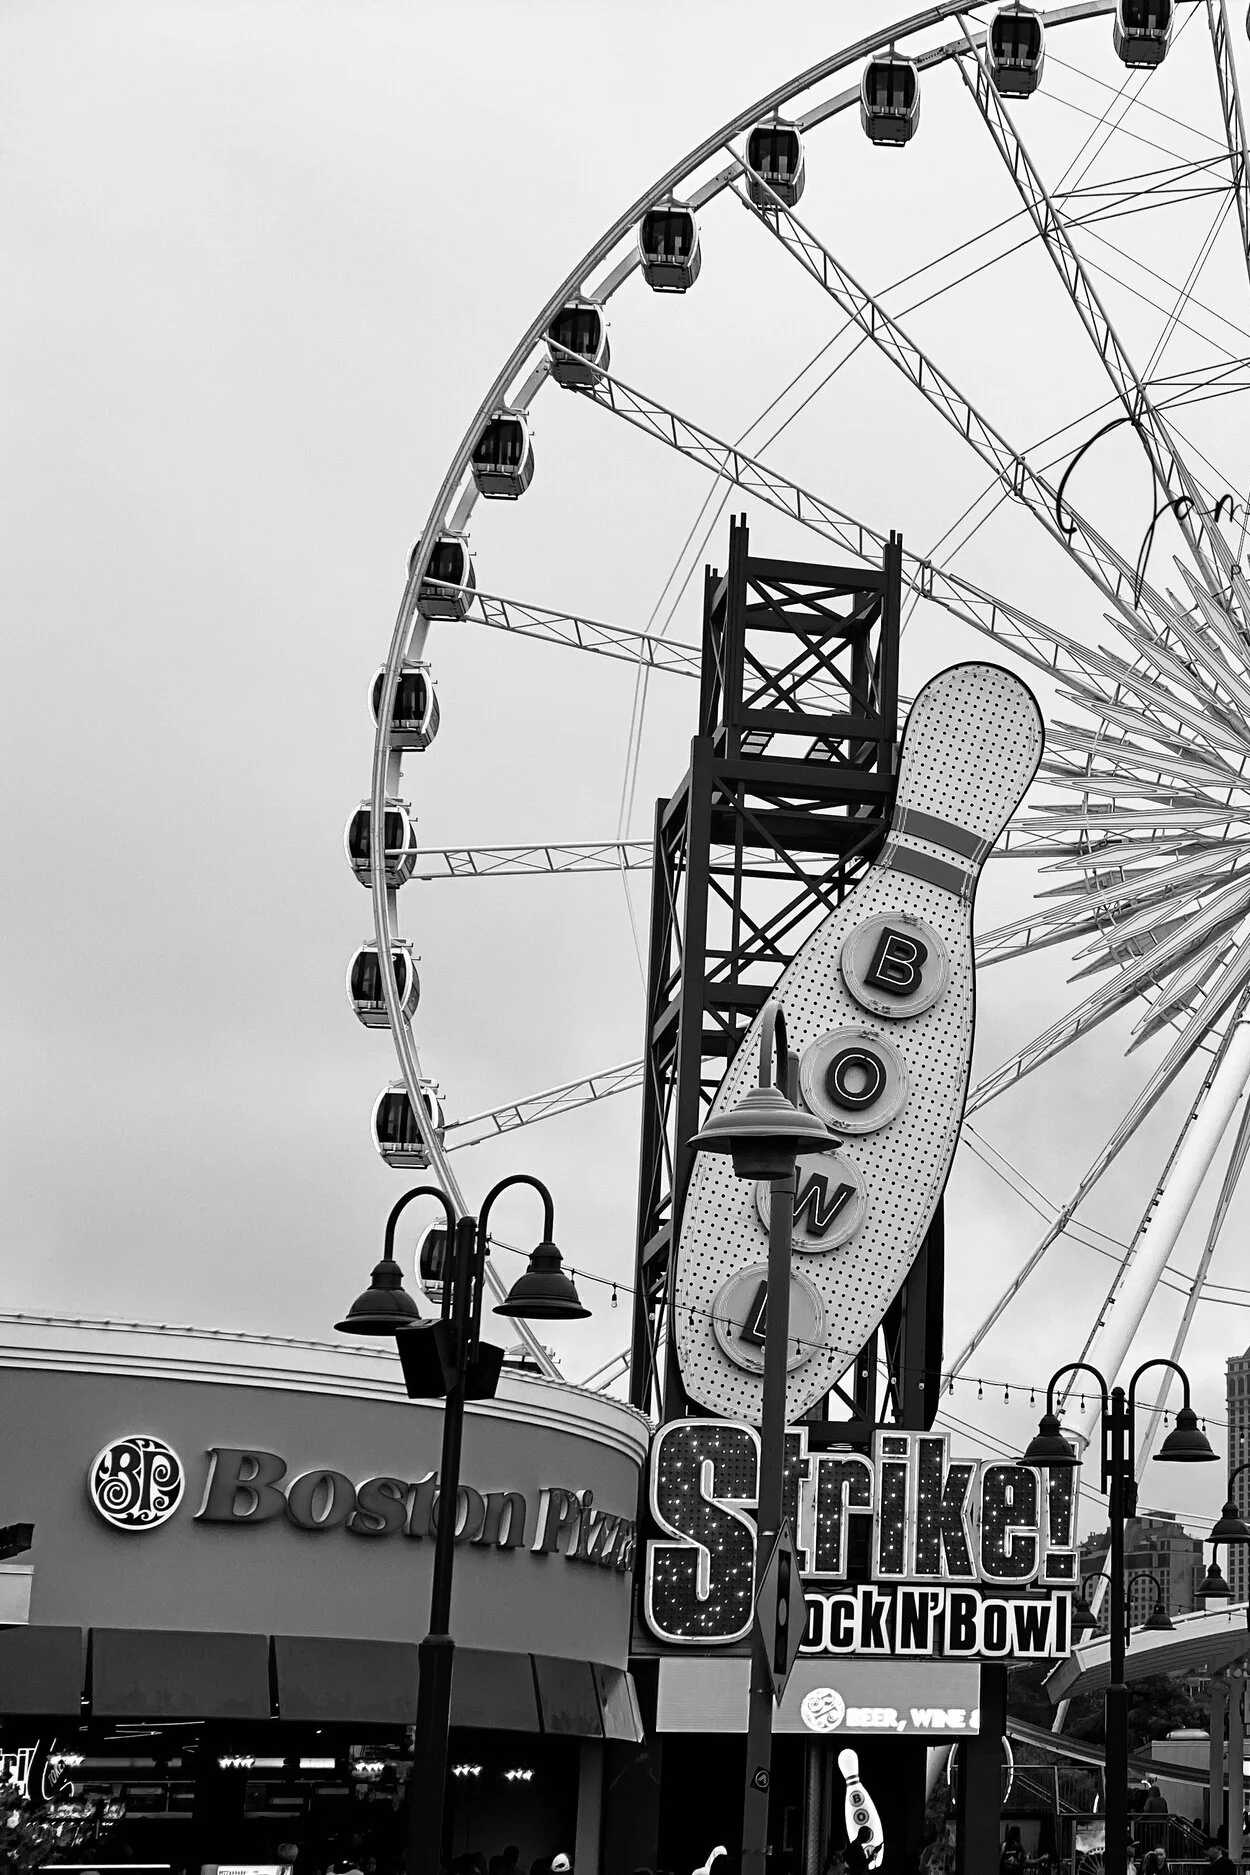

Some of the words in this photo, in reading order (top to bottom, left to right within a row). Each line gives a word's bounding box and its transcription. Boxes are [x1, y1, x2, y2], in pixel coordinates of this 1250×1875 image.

[193, 1448, 525, 1547] Boston
[800, 1584, 892, 1654] ock
[846, 1708, 907, 1731] BEER,
[910, 1709, 966, 1728] WINE
